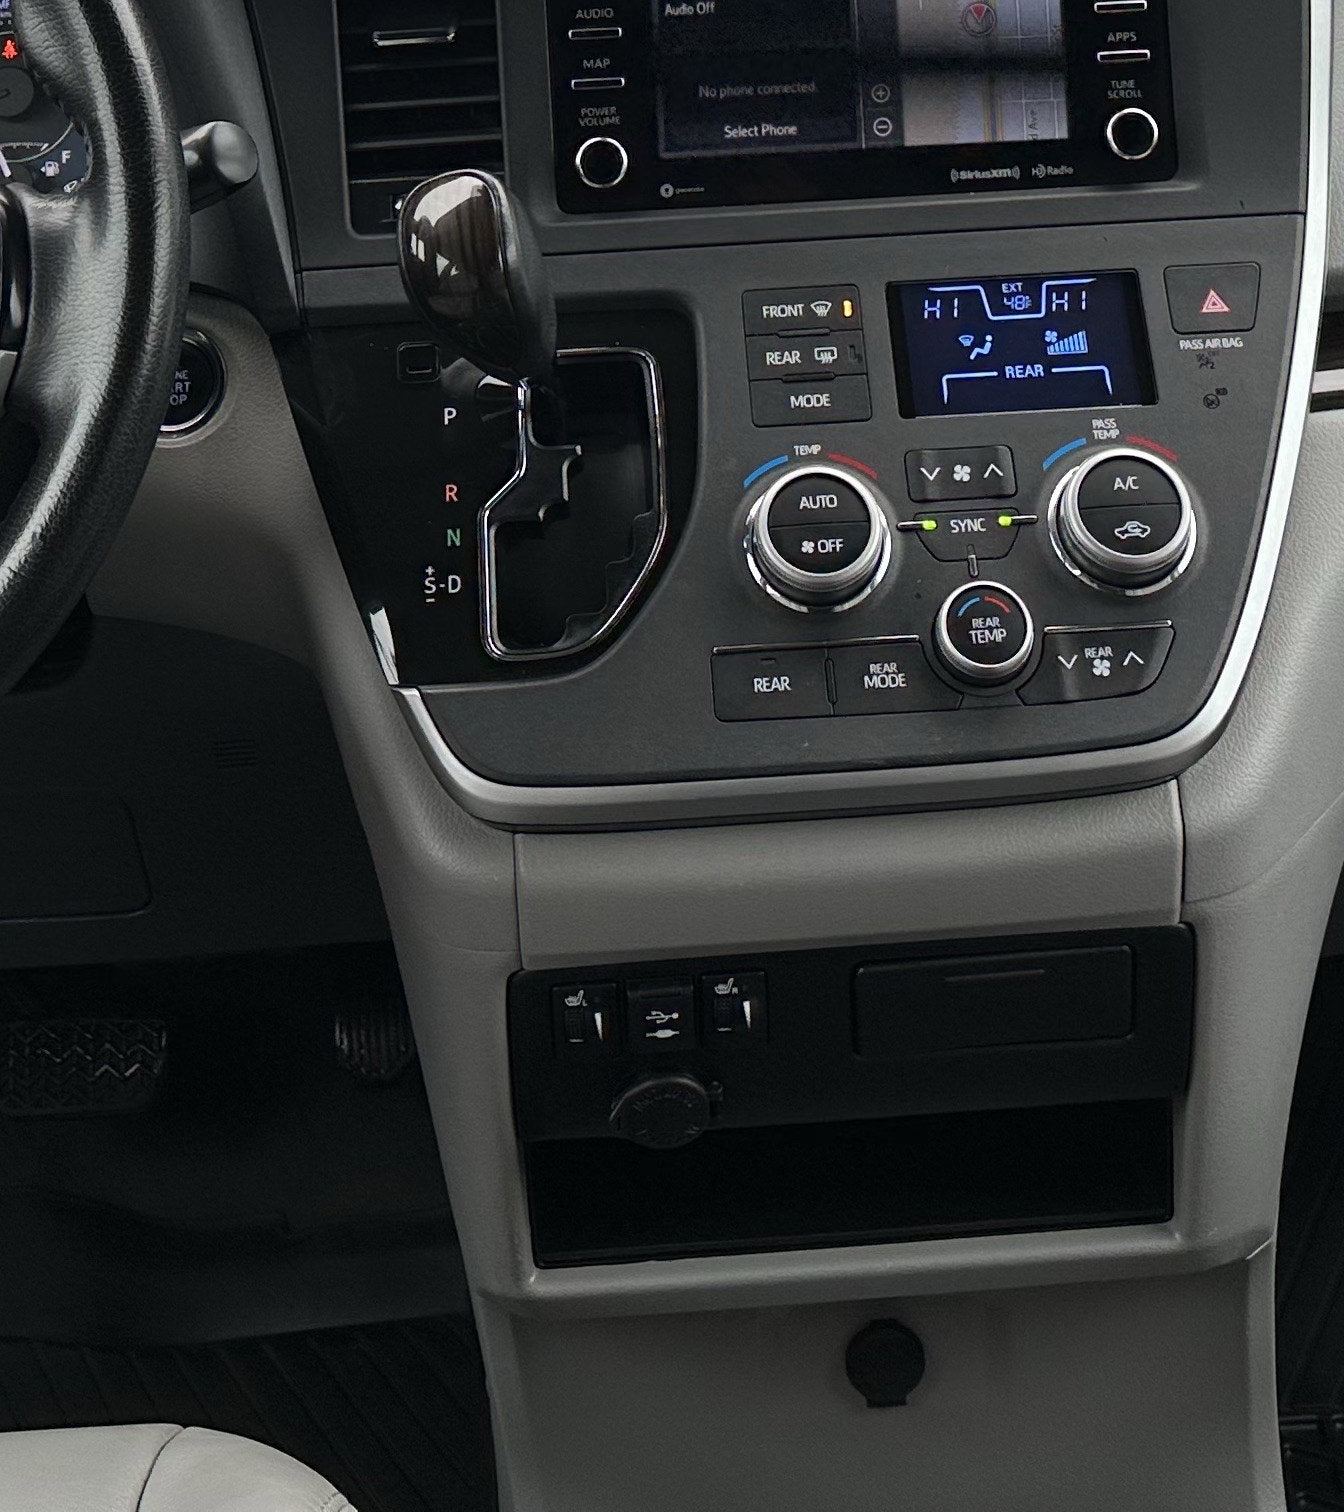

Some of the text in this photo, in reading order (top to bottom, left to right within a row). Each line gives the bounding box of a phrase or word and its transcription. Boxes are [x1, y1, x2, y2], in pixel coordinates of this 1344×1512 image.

[575, 7, 614, 19] AUDIO
[664, 1, 716, 16] Audio Off
[1107, 31, 1137, 43] APPS
[583, 57, 611, 69] MAP
[698, 81, 816, 99] No phone connected
[1110, 79, 1136, 90] TUNE
[1107, 88, 1143, 99] SCROLL
[580, 106, 617, 118] POWER
[578, 116, 621, 127] VOLUME
[724, 121, 798, 139] Select Phone
[61, 150, 71, 164] F
[1001, 282, 1024, 294] EXT
[762, 303, 805, 318] FRONT
[1179, 339, 1204, 350] PASS
[765, 349, 802, 366] REAR
[1004, 363, 1045, 379] REAR
[789, 392, 832, 409] MODE
[443, 407, 457, 425] P
[1091, 417, 1117, 429] PASS
[1092, 428, 1120, 440] TEMP
[793, 443, 822, 457] TEMP
[1113, 475, 1140, 491] A/C
[445, 484, 458, 502] R
[798, 494, 839, 510] AUTO
[949, 517, 987, 534] SYNC
[447, 528, 461, 547] N
[816, 537, 845, 554] OFF
[971, 616, 1001, 629] REAR
[968, 628, 1007, 645] TEMP
[1084, 646, 1114, 659] REAR
[869, 661, 898, 675] REAR
[753, 676, 792, 694] REAR
[863, 673, 907, 690] MODE
